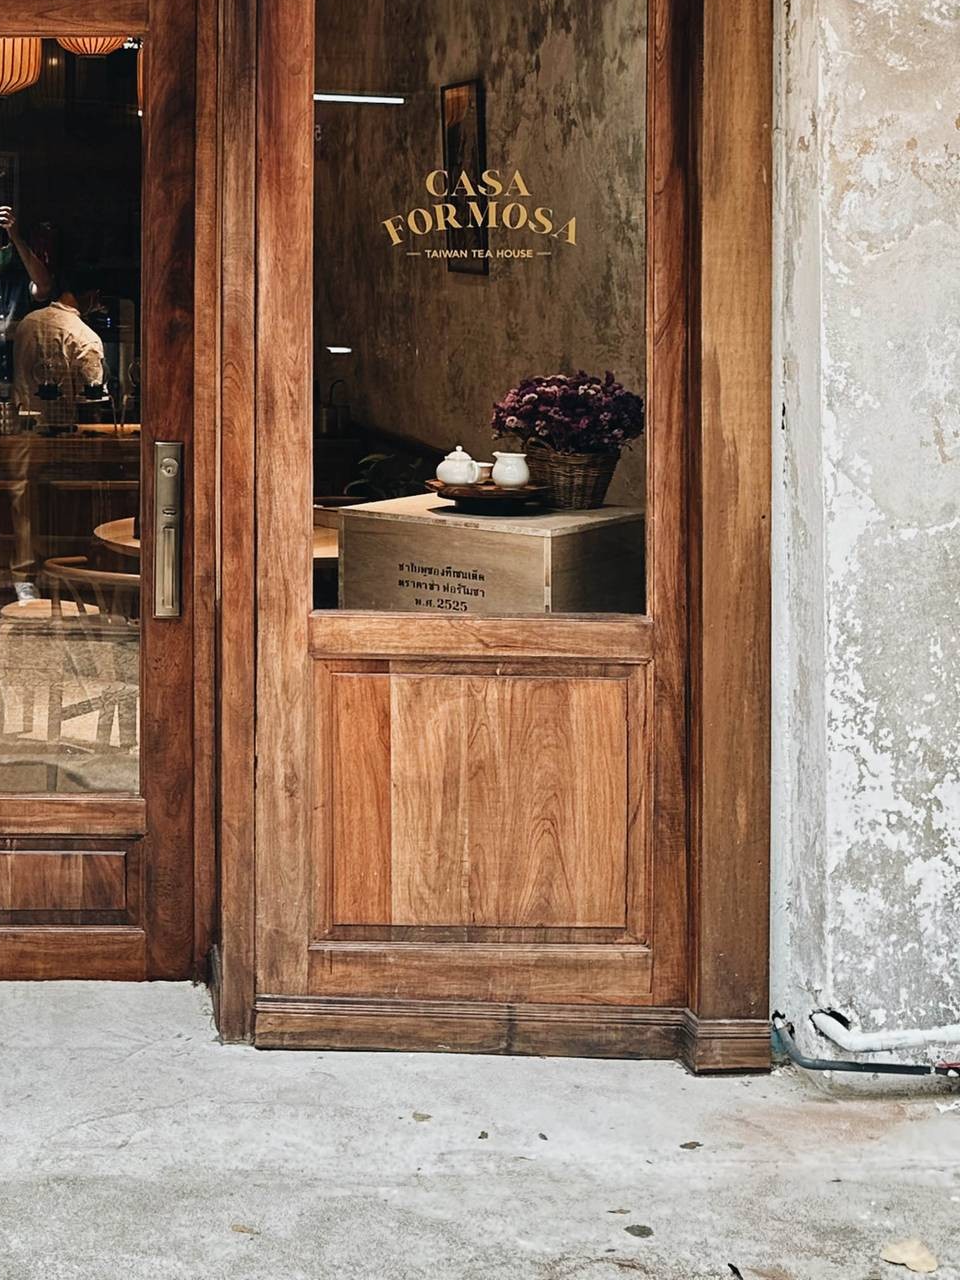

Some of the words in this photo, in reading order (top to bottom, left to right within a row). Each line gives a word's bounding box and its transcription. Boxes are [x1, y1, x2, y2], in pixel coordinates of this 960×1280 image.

[425, 169, 532, 197] CASA
[381, 201, 577, 247] FORMOSA
[425, 249, 468, 259] TAIWAN
[471, 249, 493, 259] TEA
[496, 249, 534, 259] HOUSE
[437, 598, 468, 612] 2525
